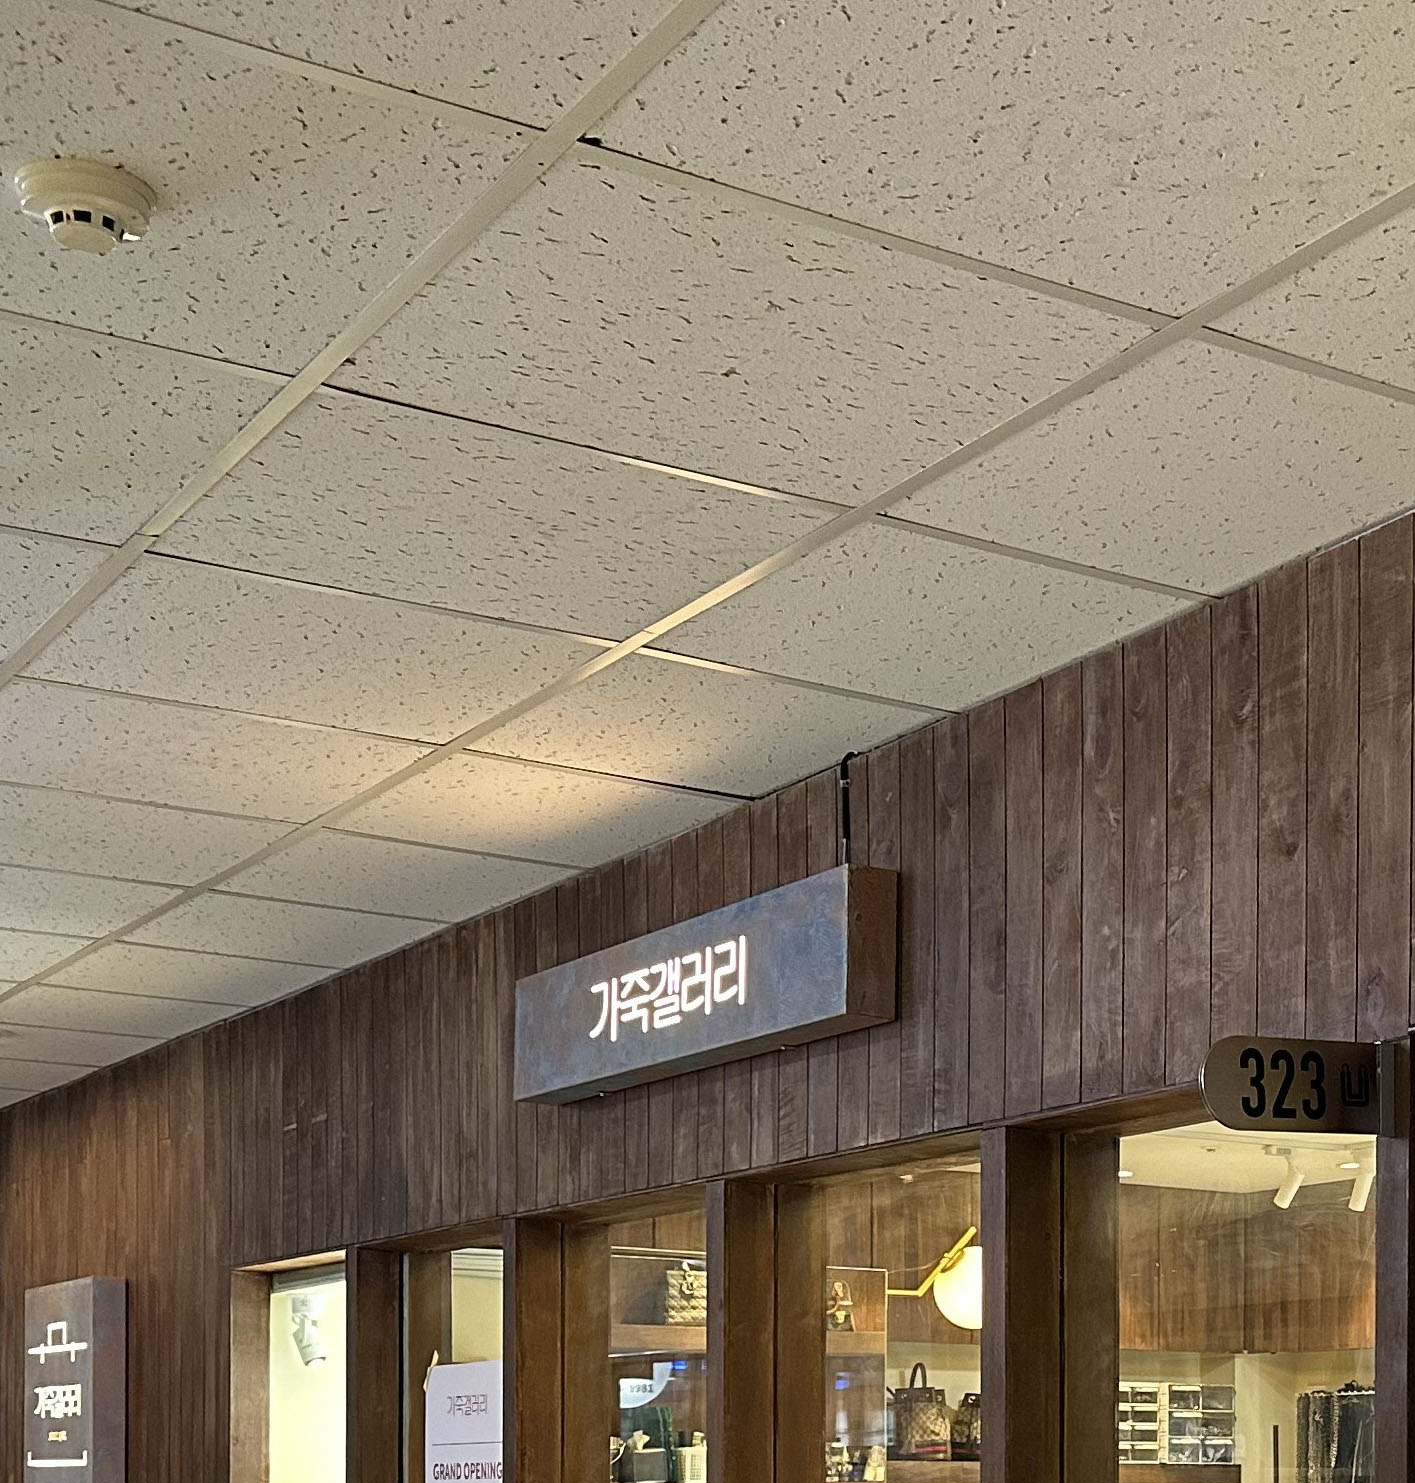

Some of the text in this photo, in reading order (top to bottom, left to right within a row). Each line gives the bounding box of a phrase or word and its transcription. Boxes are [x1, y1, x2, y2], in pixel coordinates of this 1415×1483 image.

[588, 934, 747, 1043] 가죽갤러리
[1239, 1047, 1327, 1121] 323
[447, 1393, 489, 1416] 가죽갤러리
[433, 1460, 503, 1481] GRAND OPENING
